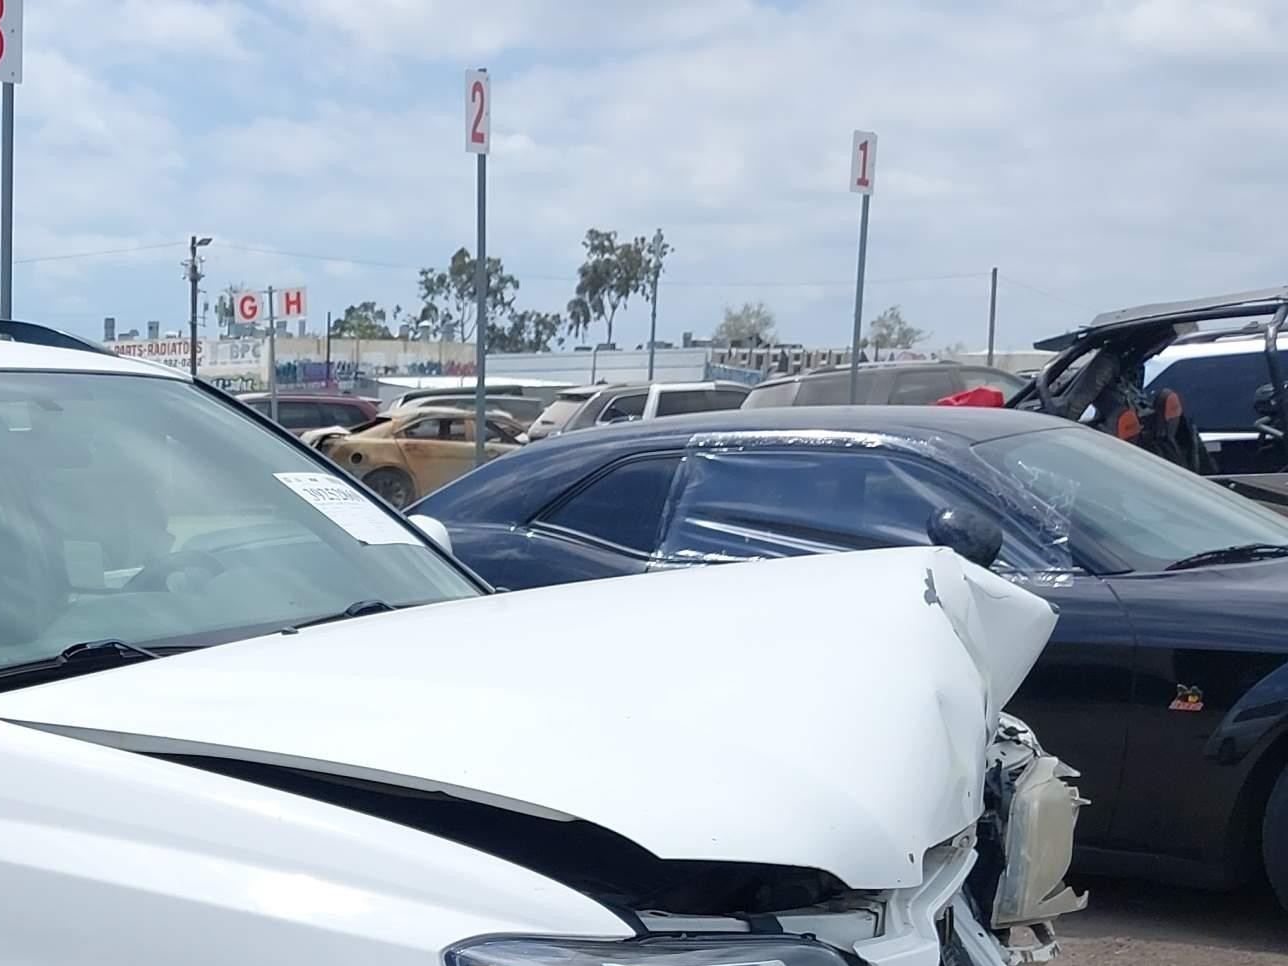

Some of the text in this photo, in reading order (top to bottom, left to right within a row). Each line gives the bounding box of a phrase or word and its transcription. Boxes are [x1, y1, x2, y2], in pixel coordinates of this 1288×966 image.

[472, 80, 484, 144] 2
[856, 140, 869, 187] 1
[240, 296, 257, 320] G
[285, 291, 301, 315] H
[114, 341, 202, 357] PARTS-RADIATOS
